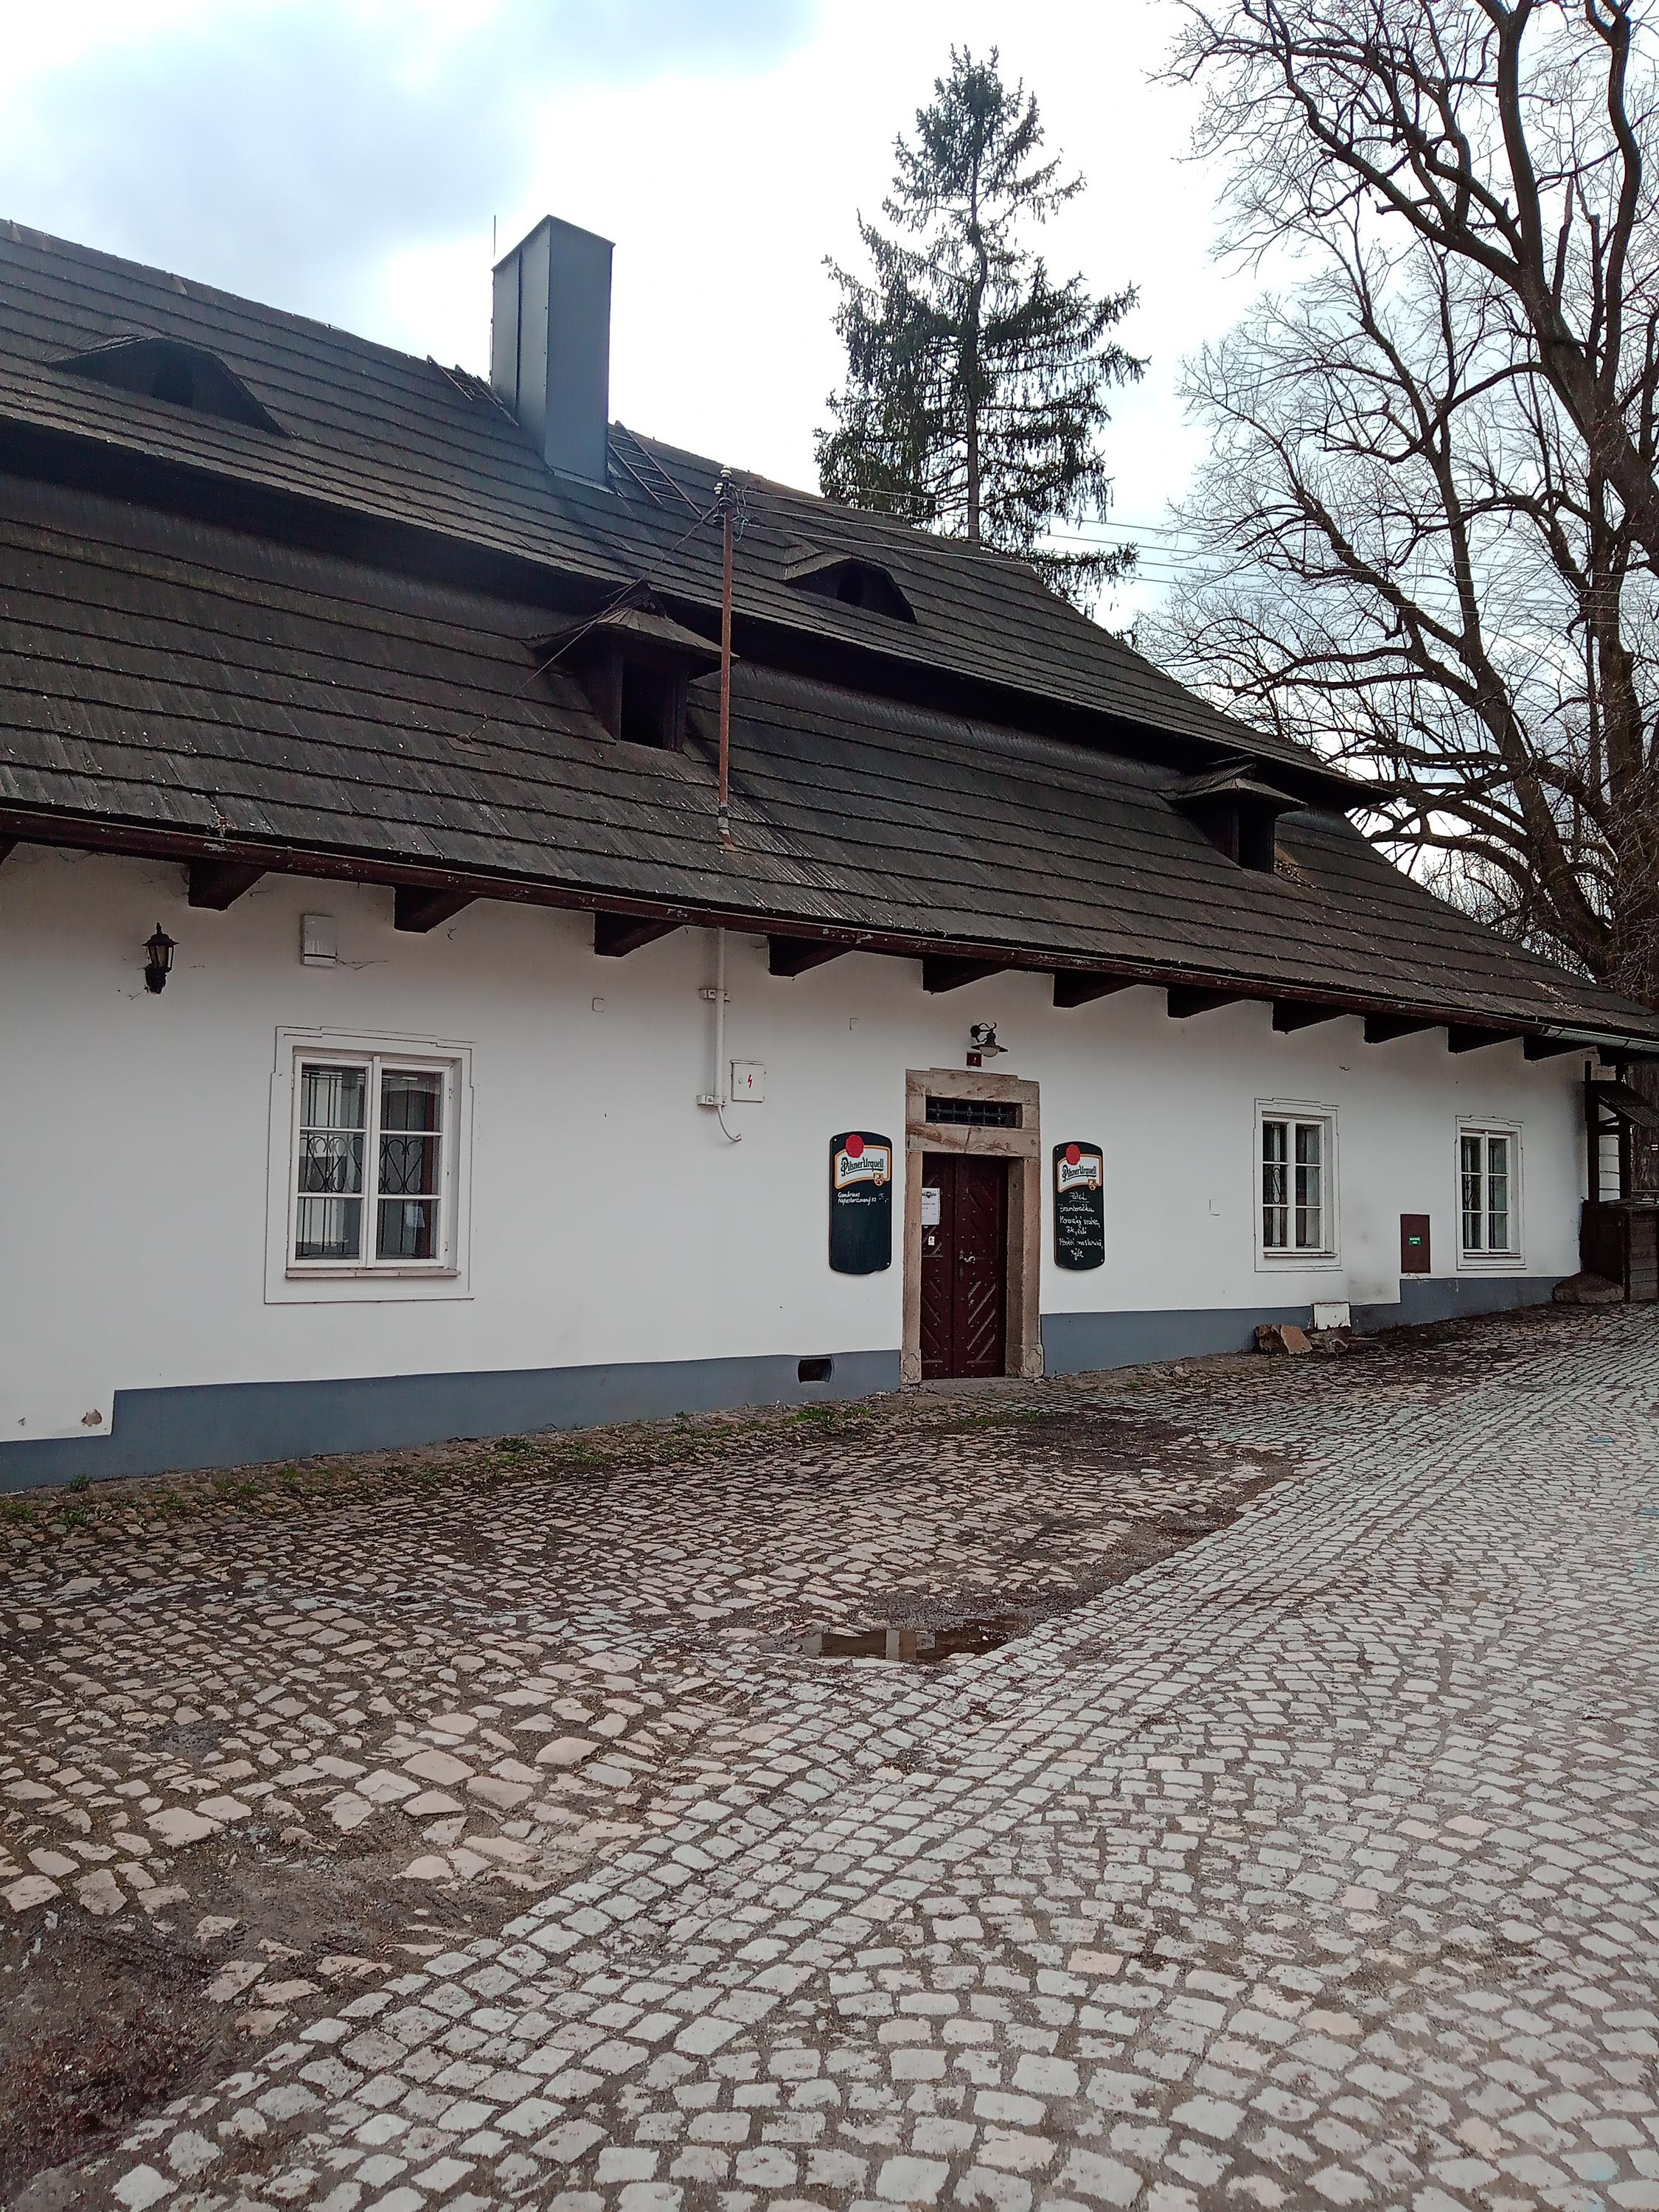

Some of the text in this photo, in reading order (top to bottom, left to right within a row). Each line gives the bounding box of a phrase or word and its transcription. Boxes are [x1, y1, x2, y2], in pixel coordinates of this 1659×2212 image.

[841, 1157, 884, 1177] Pilsner Urquell
[1062, 1164, 1096, 1183] Pilsner Urquell
